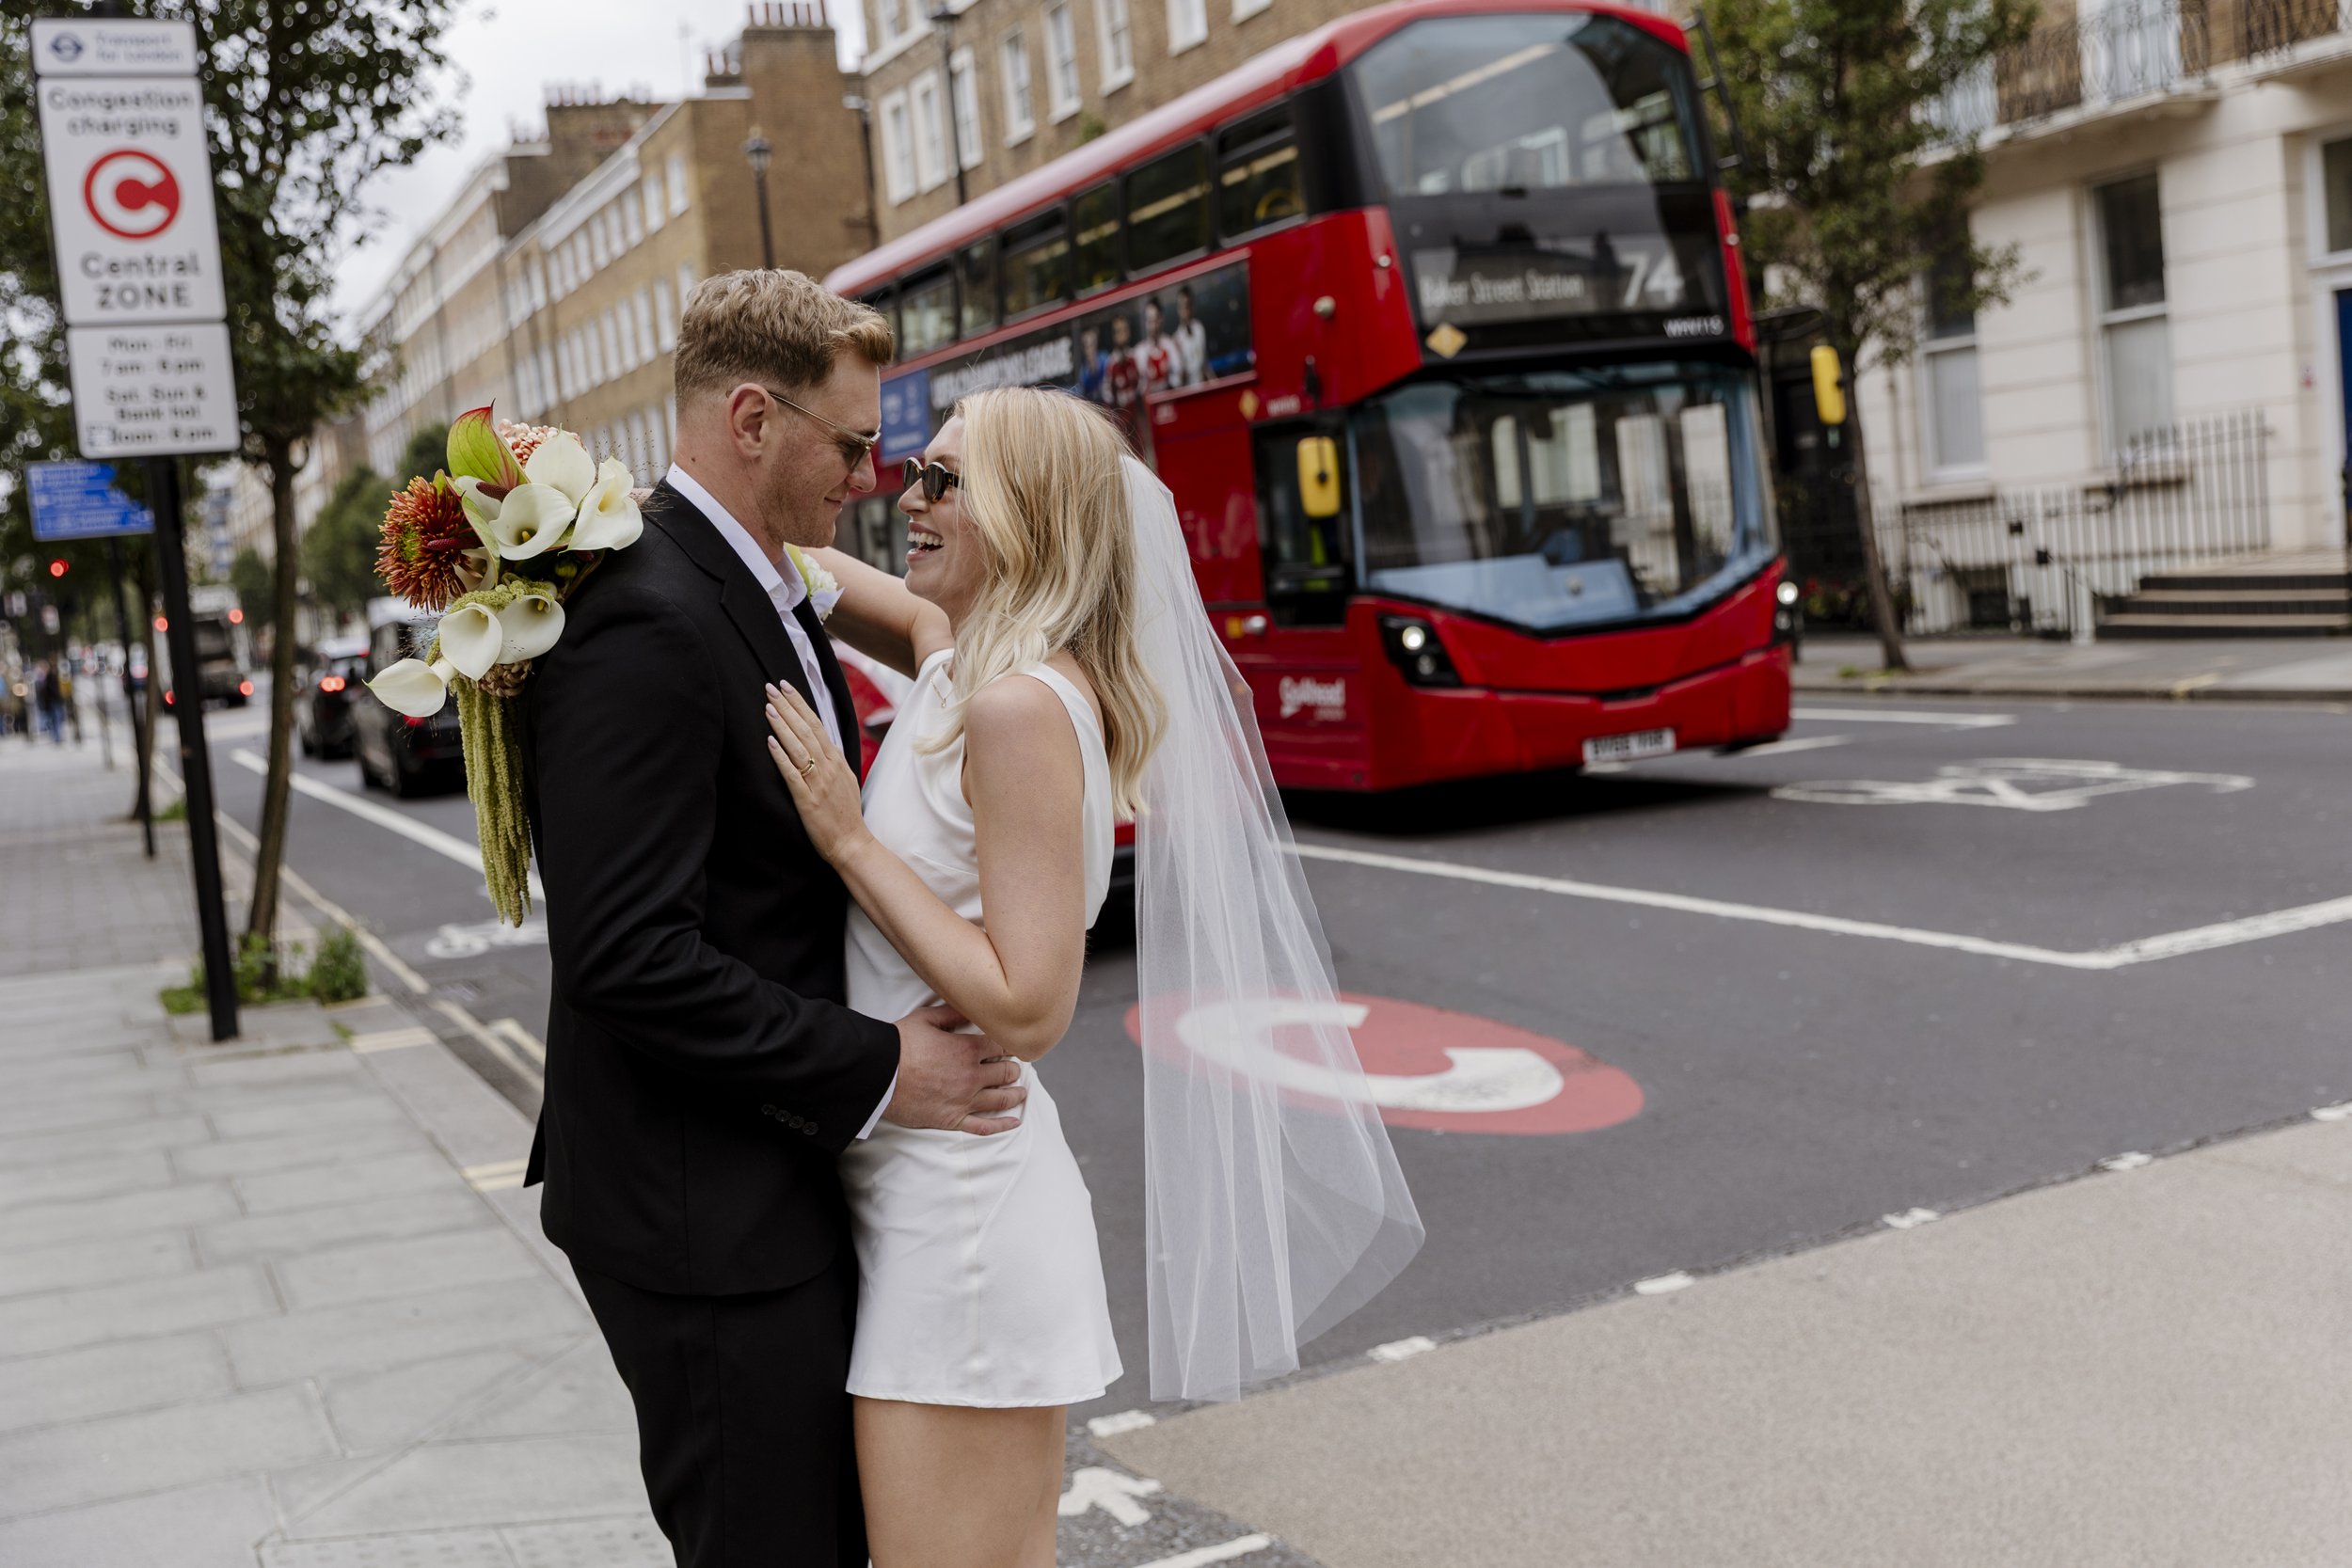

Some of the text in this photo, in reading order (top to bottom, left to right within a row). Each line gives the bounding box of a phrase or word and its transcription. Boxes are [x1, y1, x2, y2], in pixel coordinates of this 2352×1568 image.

[48, 87, 194, 111] Congestion
[68, 114, 181, 139] charging
[80, 250, 200, 278] Central
[1419, 268, 1584, 307] Baker Street Station
[1619, 250, 1684, 309] 74
[95, 283, 191, 310] ZONE
[108, 336, 151, 354] Mon
[151, 383, 187, 403] Sun
[115, 407, 163, 423] Bank
